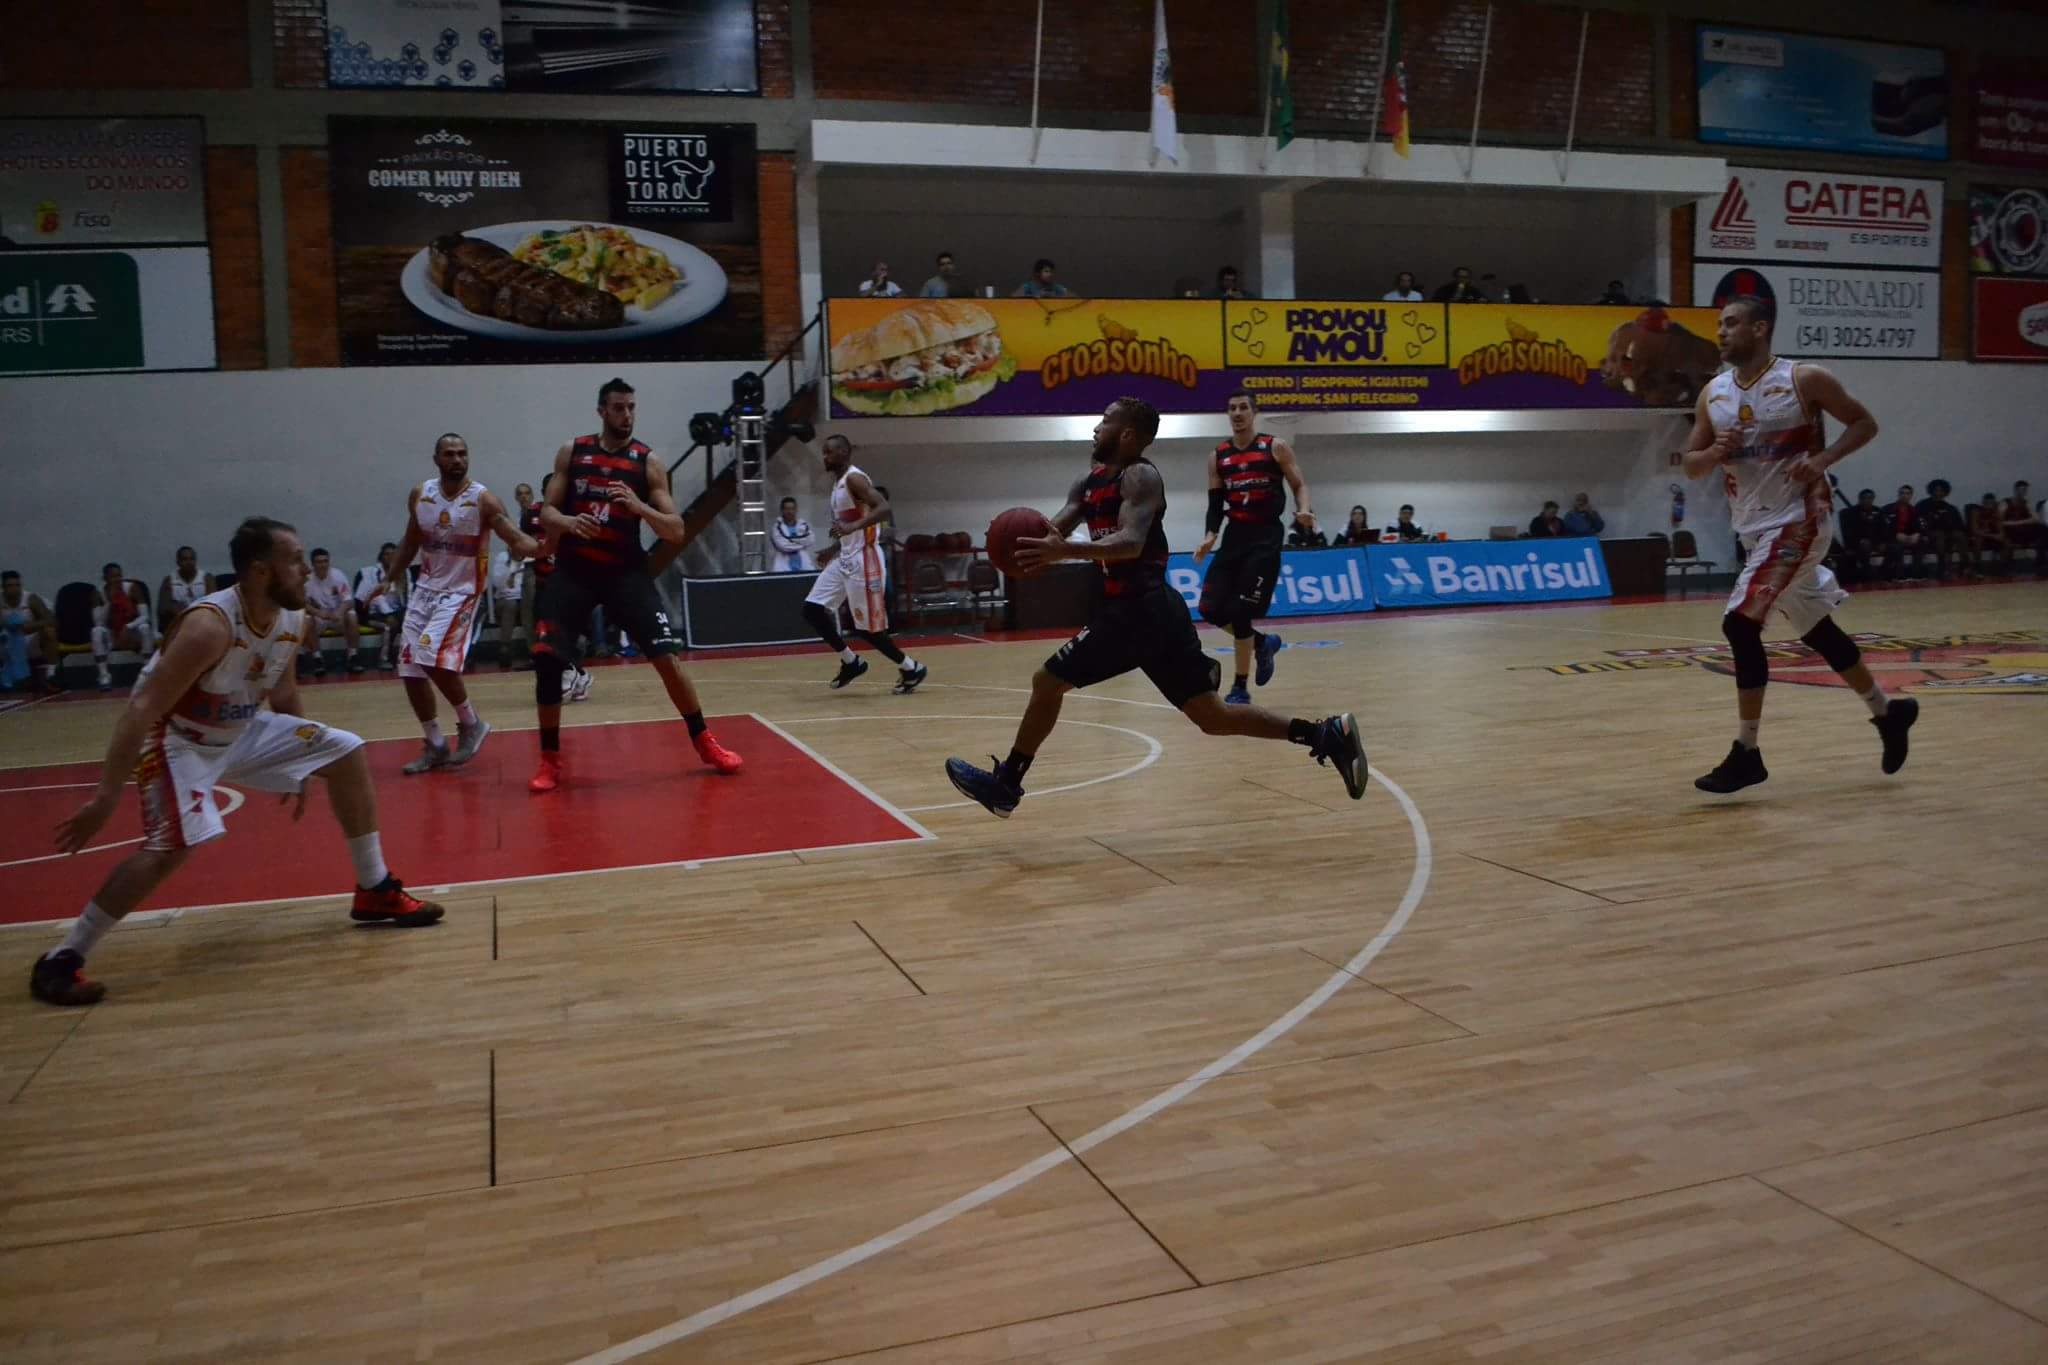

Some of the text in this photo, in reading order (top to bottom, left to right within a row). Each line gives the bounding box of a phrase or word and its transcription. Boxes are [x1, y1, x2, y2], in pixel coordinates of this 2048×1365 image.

[624, 138, 708, 158] PUERTO
[368, 169, 521, 189] COMER MUY BIEN
[625, 159, 665, 179] DEL
[626, 181, 685, 200] TORO
[1785, 179, 1932, 220] CATERA
[1850, 232, 1930, 248] ESPORTES
[1788, 277, 1926, 310] BERNARDI
[1286, 309, 1387, 333] PROVOU
[1287, 331, 1388, 363] AMOU.
[1796, 325, 1917, 350] (54) 3025.4797
[1040, 336, 1199, 390] croasonho
[1459, 338, 1588, 388] croasonho
[1240, 375, 1430, 390] CENTRO SHOPPING IGUATEMI
[1255, 392, 1321, 406] SHOPPING
[1322, 393, 1351, 406] SAN
[1426, 547, 1601, 594] Banrisul
